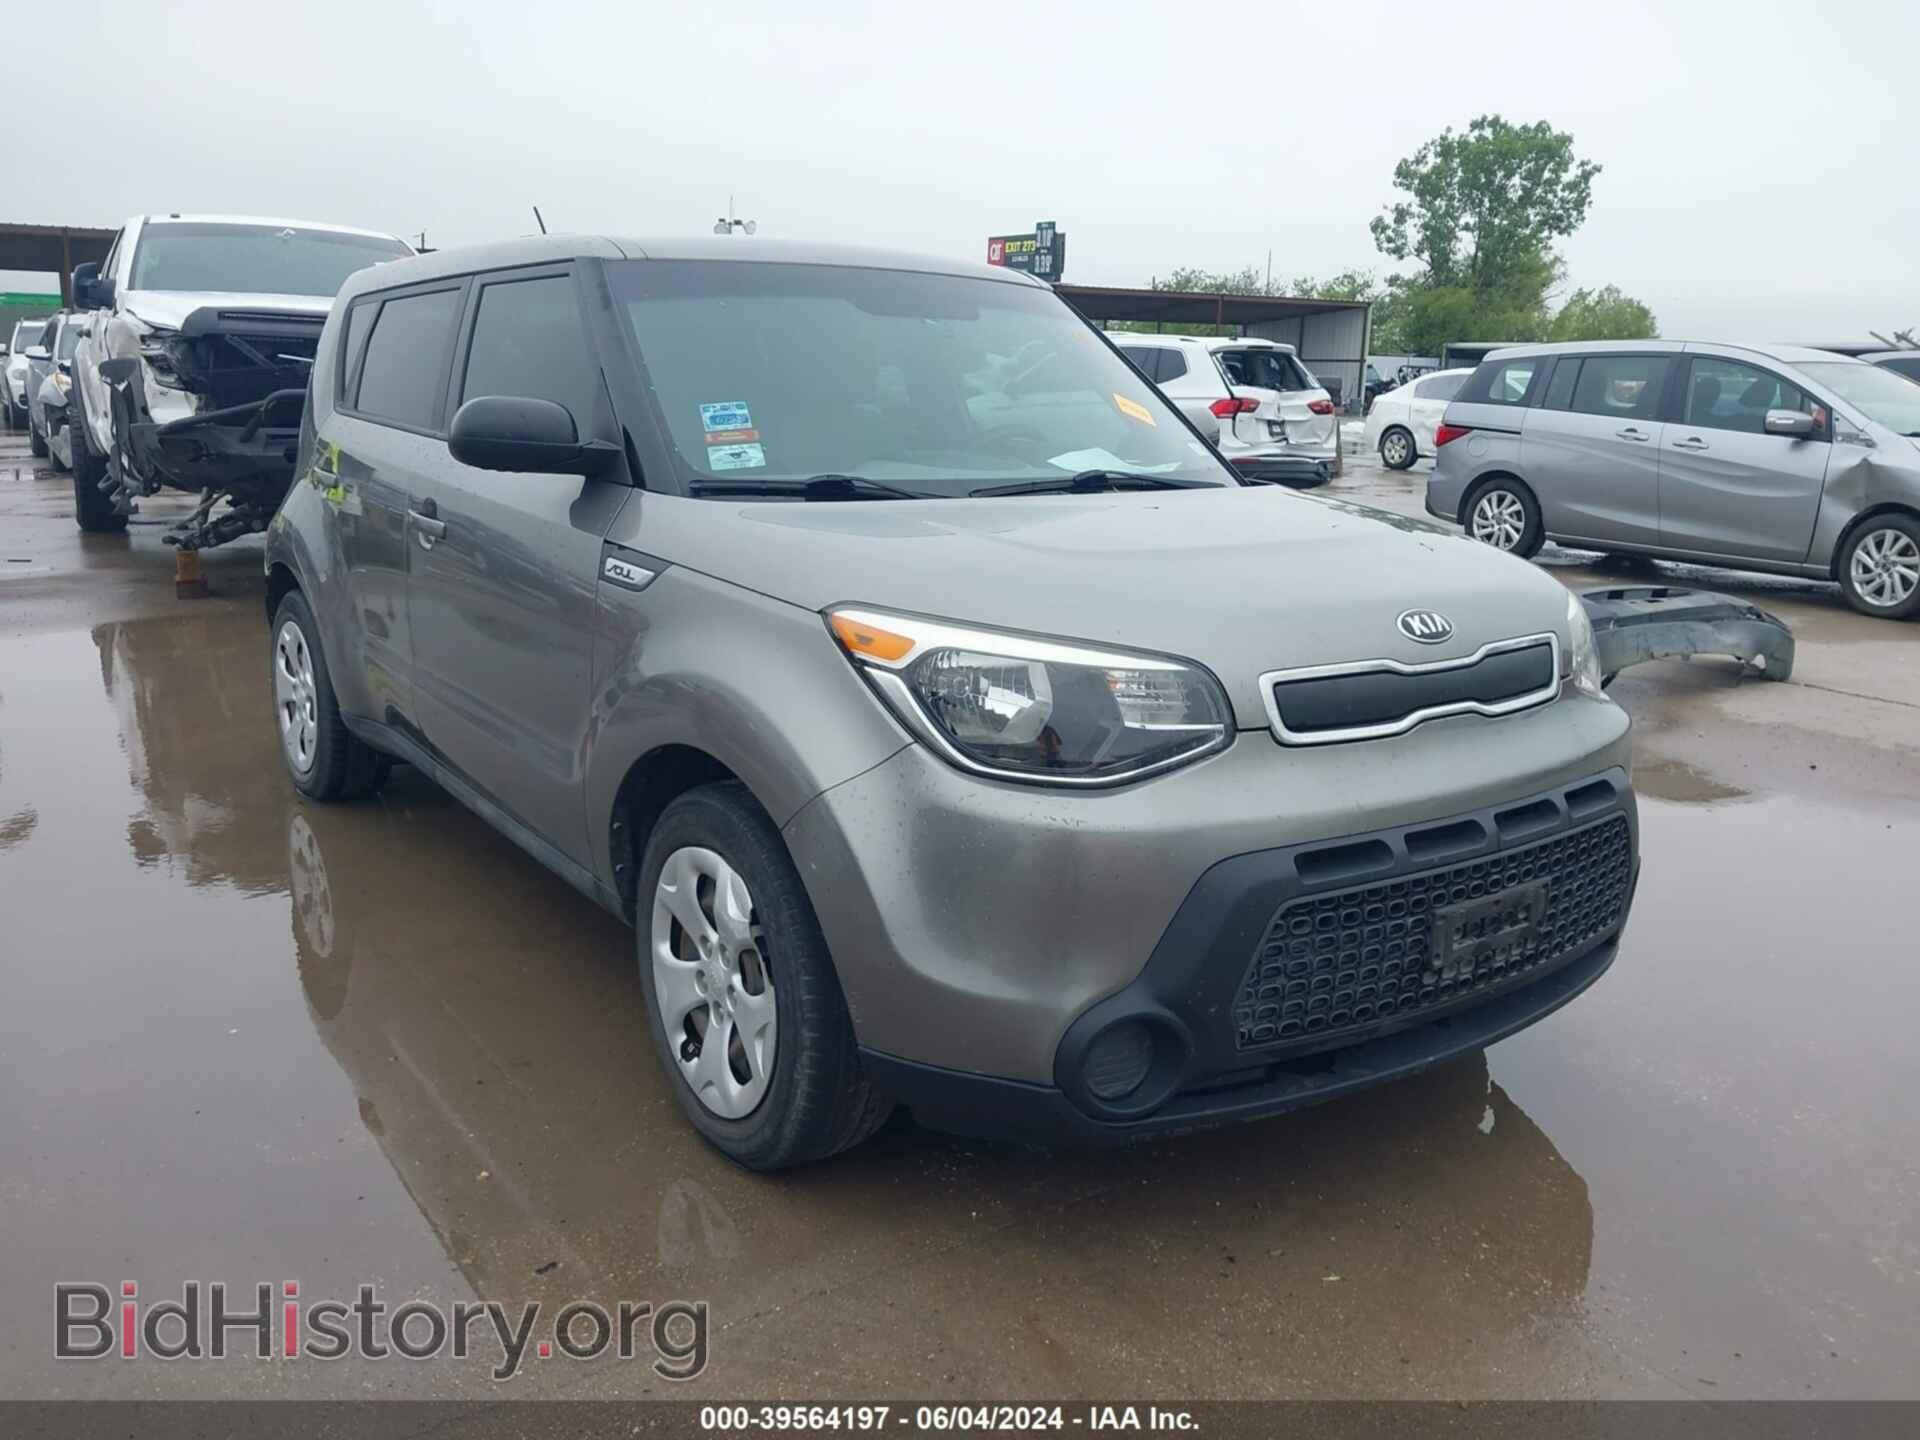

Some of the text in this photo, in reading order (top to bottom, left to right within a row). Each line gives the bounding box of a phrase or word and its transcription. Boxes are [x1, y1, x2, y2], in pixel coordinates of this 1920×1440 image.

[1005, 240, 1036, 253] EXIT 273
[1405, 613, 1451, 636] KIA
